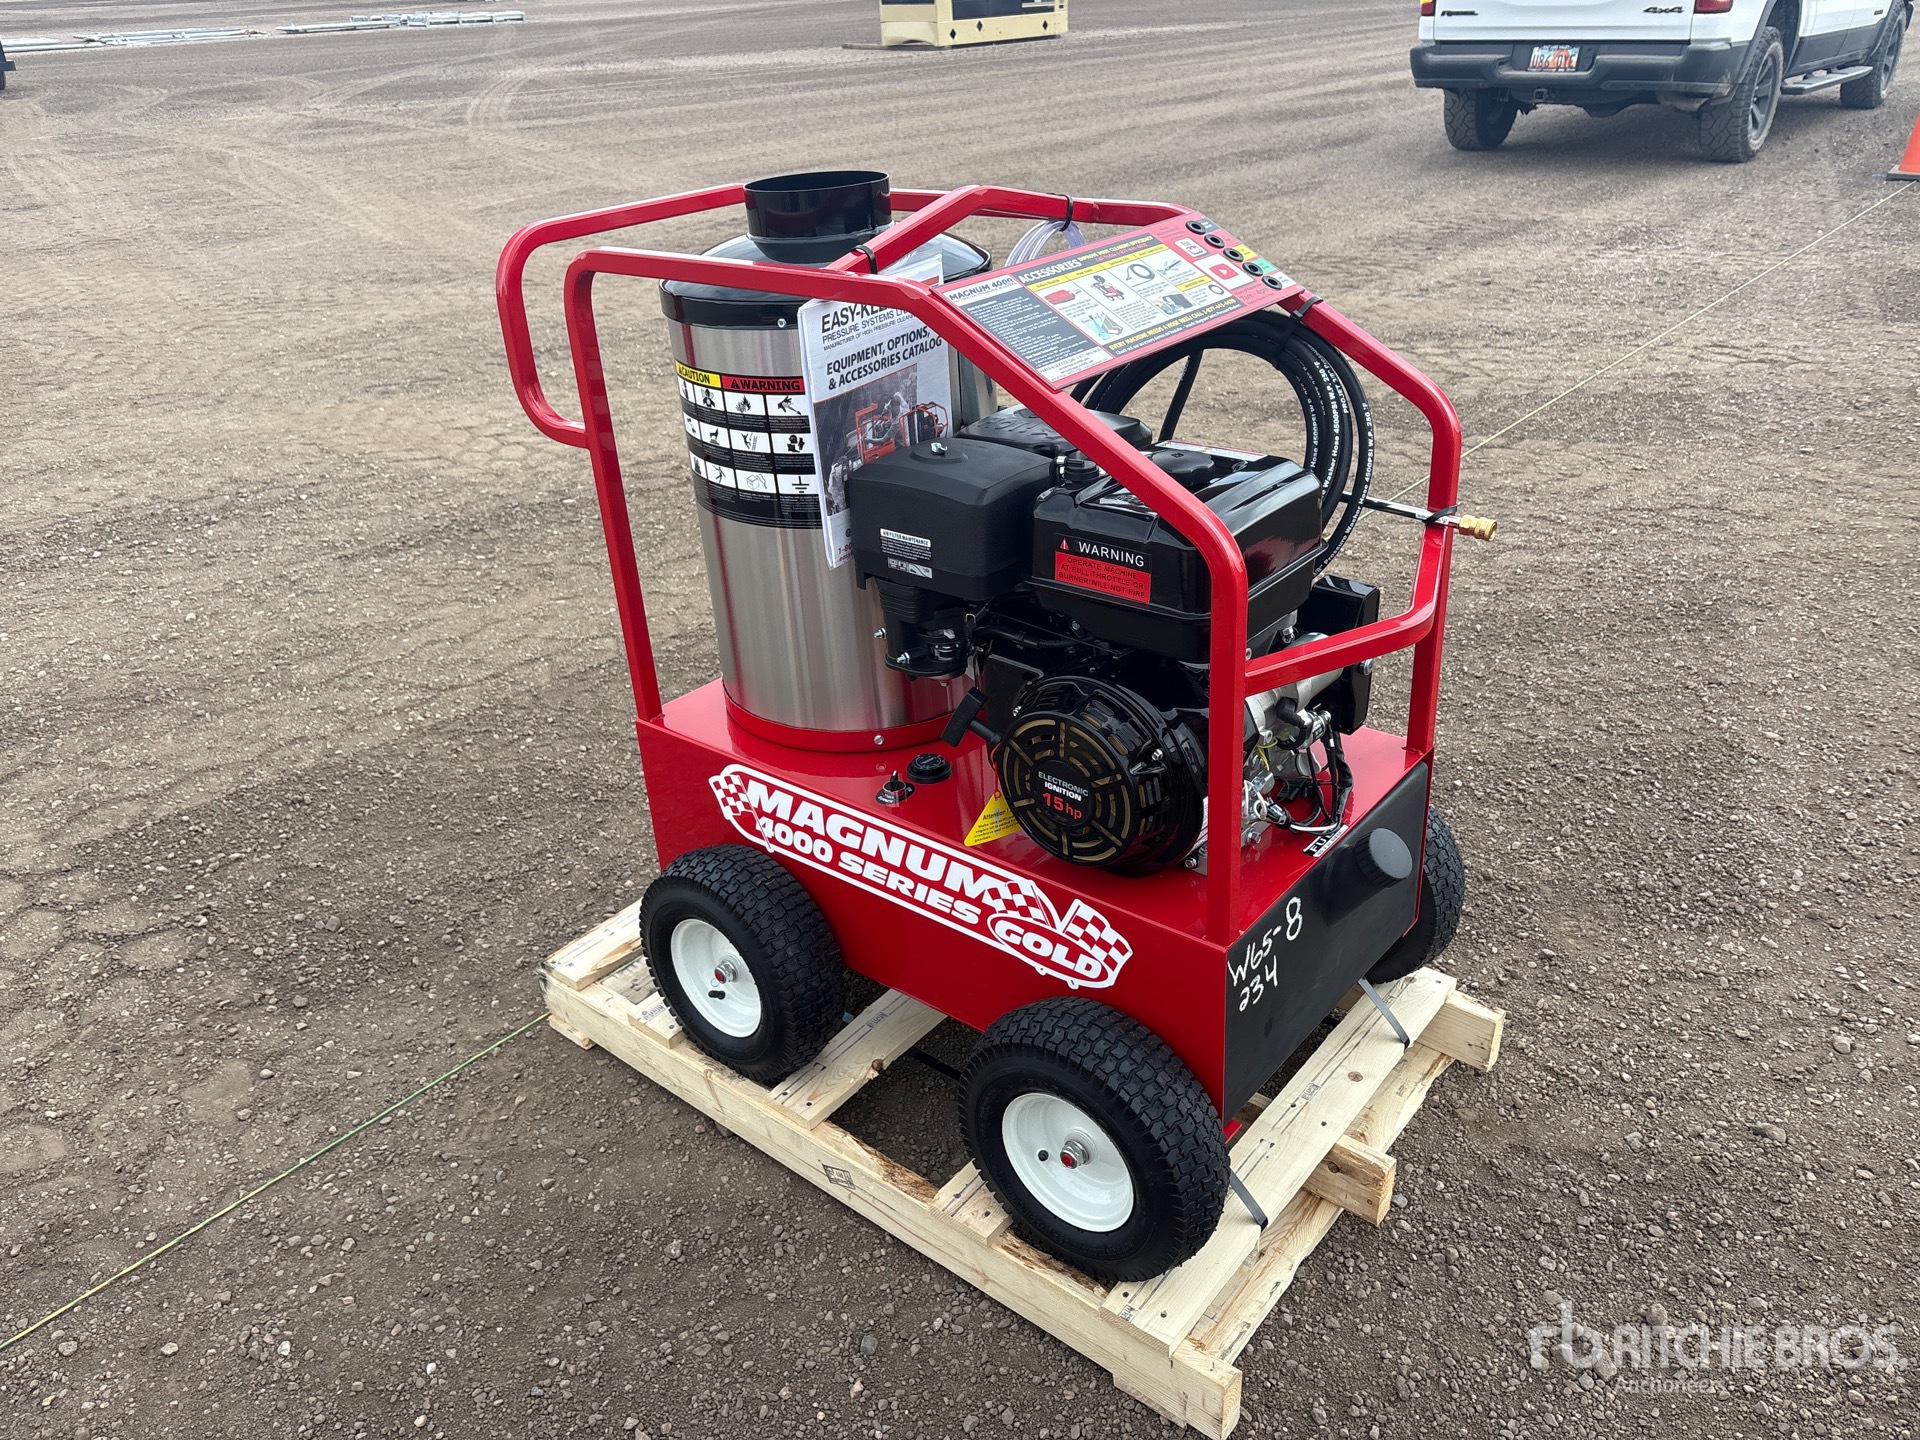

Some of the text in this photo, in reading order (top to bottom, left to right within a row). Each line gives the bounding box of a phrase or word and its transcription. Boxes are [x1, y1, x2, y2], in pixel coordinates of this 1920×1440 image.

[1643, 6, 1684, 14] 4x4
[1018, 259, 1083, 284] ACCESSORIES
[948, 284, 991, 300] MAGNUM
[821, 303, 889, 334] EASY-KLE
[822, 324, 860, 344] PRESSURE
[861, 310, 894, 329] SYSTEMS
[823, 334, 855, 352] MANUFACTURER
[855, 332, 862, 340] OF
[873, 320, 897, 333] PRESSURE
[826, 342, 886, 375] EQUIPMENT,
[887, 326, 931, 351] OPTIONS,
[828, 335, 942, 391] & ACCESSORIES CATALOG
[681, 366, 710, 384] CAUTION
[740, 379, 801, 391] WARNING
[1319, 368, 1330, 382] 250
[1331, 401, 1340, 434] 4500PSI
[1365, 411, 1373, 427] 250
[1310, 447, 1319, 468] Hose
[1332, 436, 1340, 457] Hose
[1323, 458, 1336, 488] Washer
[1365, 449, 1373, 483] 4500PSI
[1358, 484, 1369, 505] Hose
[1345, 506, 1361, 534] Washer
[901, 535, 929, 546] MAINTENANCE
[1078, 541, 1144, 567] WARNING
[1067, 557, 1137, 579] OPERATE MACHINE
[1072, 567, 1089, 577] FULL
[1092, 571, 1130, 586] THROTTLE
[1058, 572, 1089, 583] BURNER
[1091, 580, 1108, 589] WILL
[1110, 584, 1126, 593] NOT
[1038, 771, 1089, 797] ELECTRONIC
[1044, 781, 1082, 802] IGNITION
[745, 779, 1000, 902] MAGNUM
[755, 815, 982, 925] 4000 SERIES
[996, 918, 1102, 981] GOLD
[1227, 896, 1303, 987] W65-8
[1239, 955, 1278, 1012] 234
